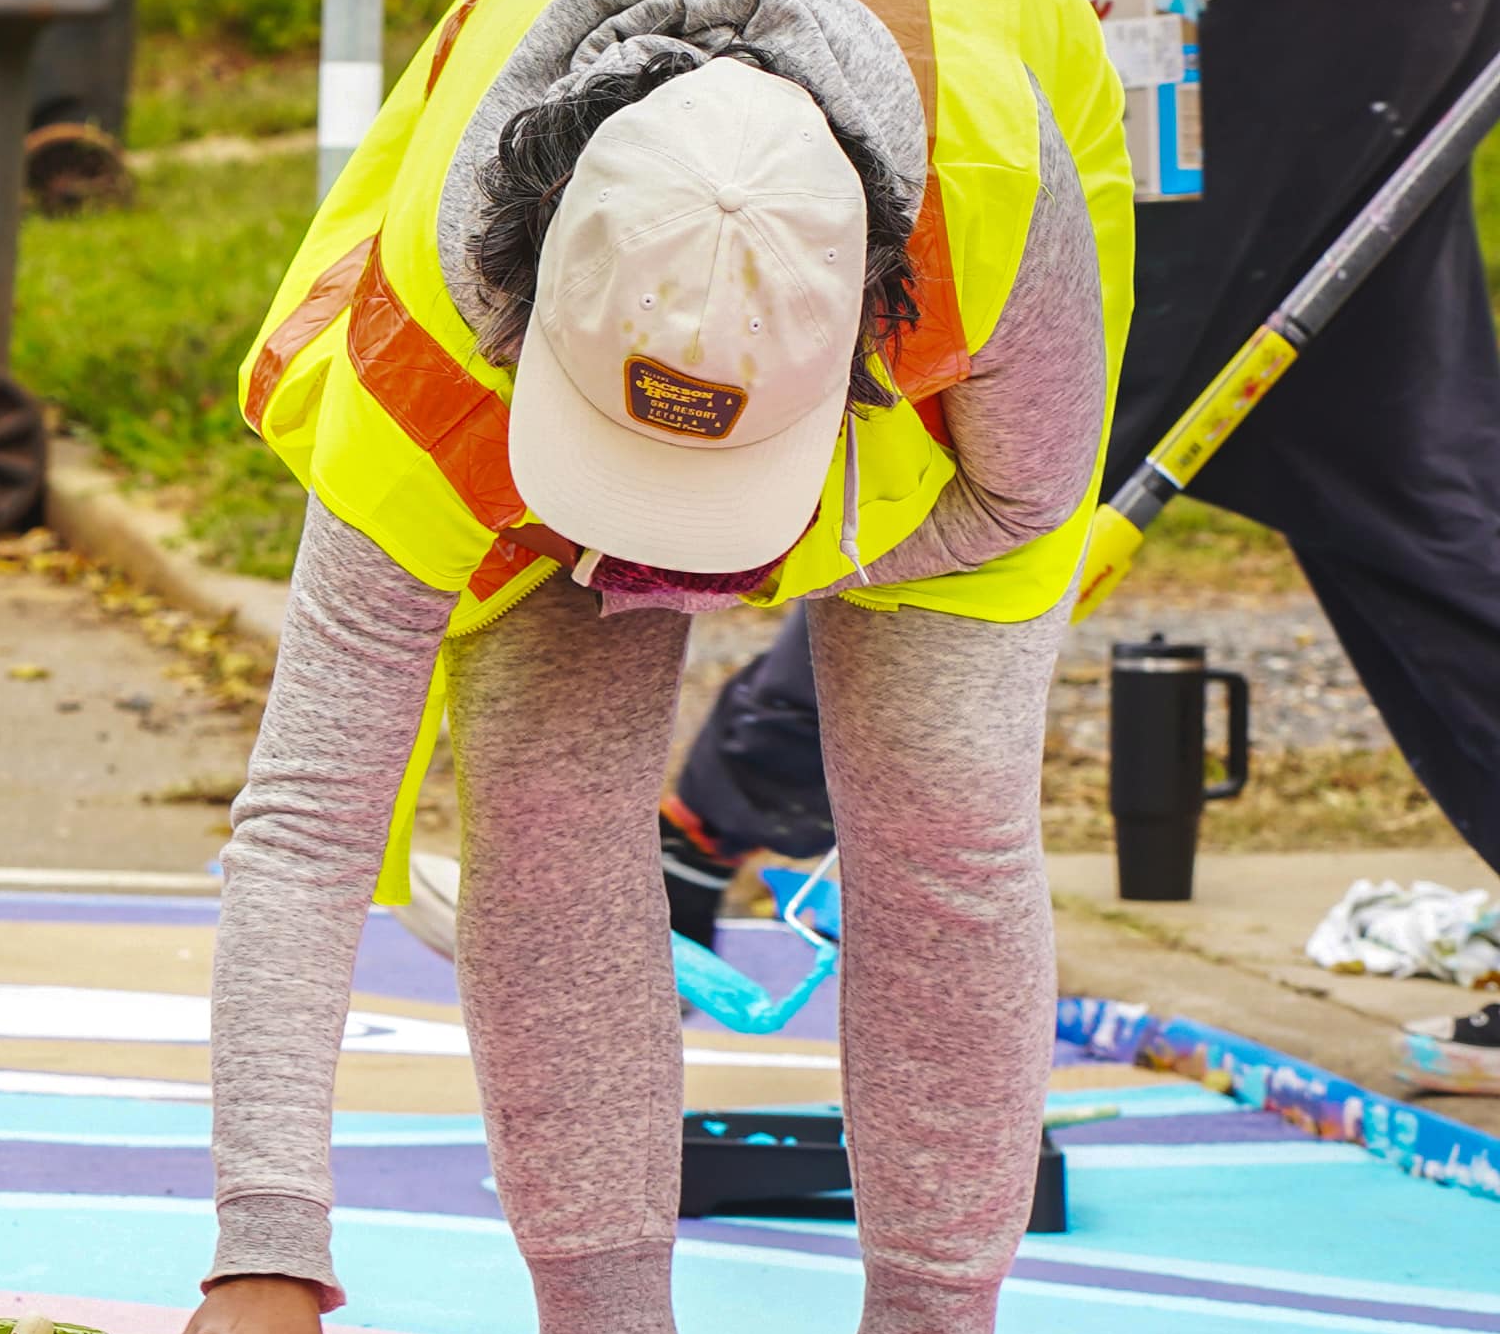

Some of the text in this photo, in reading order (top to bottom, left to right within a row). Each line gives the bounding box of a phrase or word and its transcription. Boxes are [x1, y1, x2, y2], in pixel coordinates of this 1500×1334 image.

[636, 375, 714, 399] JACKSON
[650, 399, 718, 420] SKI RESORT
